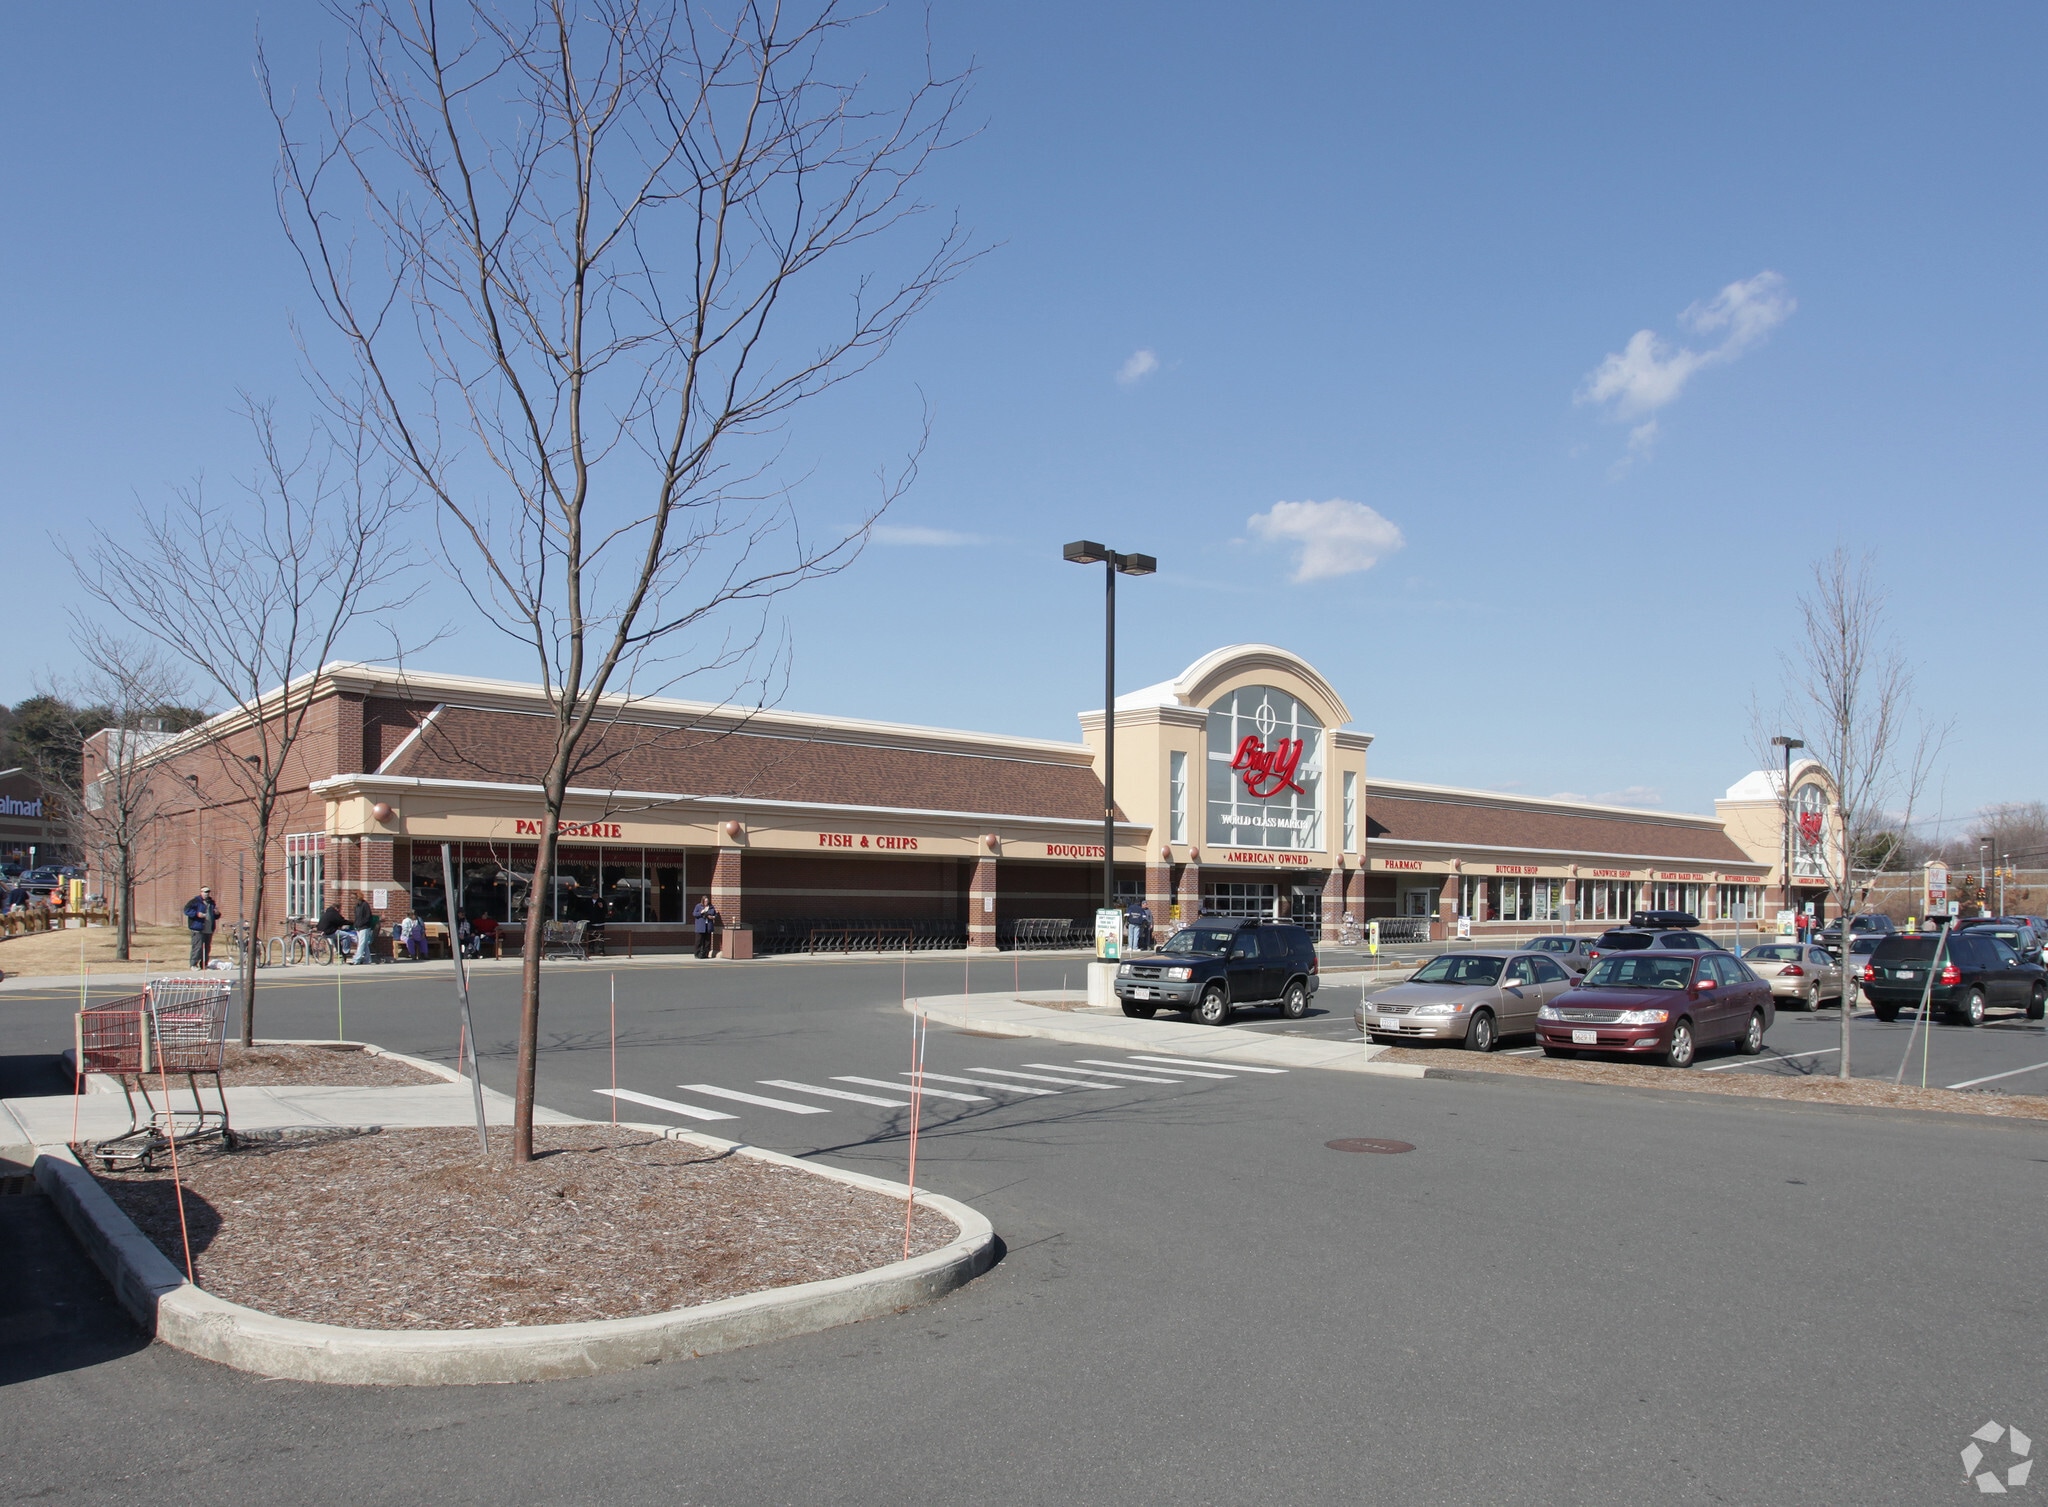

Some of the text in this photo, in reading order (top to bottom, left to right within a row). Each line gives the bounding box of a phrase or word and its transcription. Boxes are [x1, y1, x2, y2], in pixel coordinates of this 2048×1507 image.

[1221, 814, 1251, 826] WORLD
[1252, 816, 1277, 828] CLASS
[515, 819, 622, 838] PATSSERIE
[818, 833, 918, 850] FISH & CHIPS
[1047, 844, 1105, 858] BOUQUETS
[1227, 852, 1309, 865] AMERICAN OWNED
[1385, 859, 1423, 870] PHARMACY
[1496, 865, 1538, 875] BUTCHER SHOP
